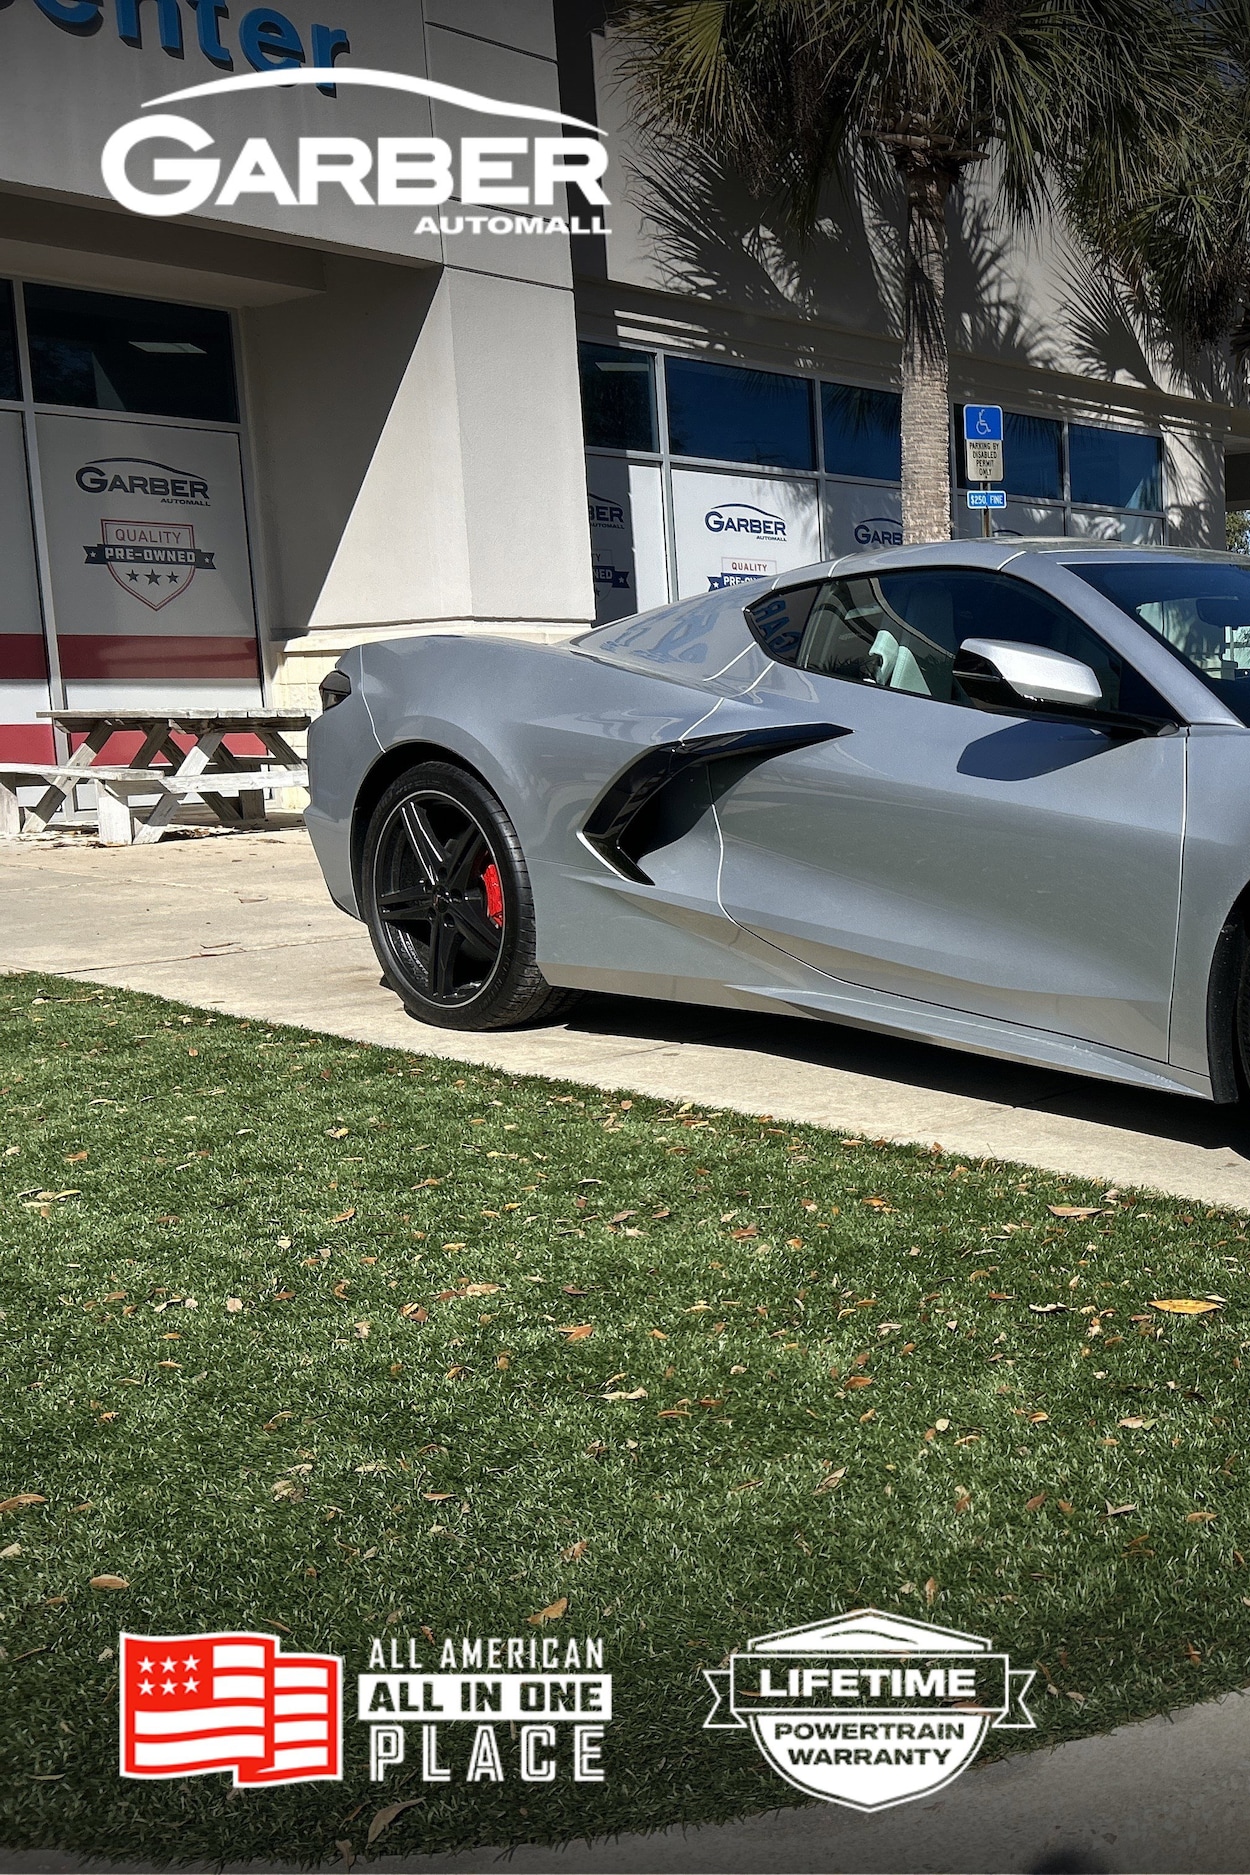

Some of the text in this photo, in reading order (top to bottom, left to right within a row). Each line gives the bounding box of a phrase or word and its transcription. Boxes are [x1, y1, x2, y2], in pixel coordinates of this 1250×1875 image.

[969, 442, 999, 450] PARKING BY
[973, 450, 997, 459] DISABLED
[976, 459, 994, 467] PERMIT
[979, 467, 992, 476] ONLY
[160, 498, 211, 507] AUTOMALL
[990, 495, 1004, 505] FINE
[115, 528, 181, 544] QUALITY
[854, 524, 903, 546] GARB
[104, 547, 196, 563] PRE-OWNED
[731, 562, 768, 572] QUALITY
